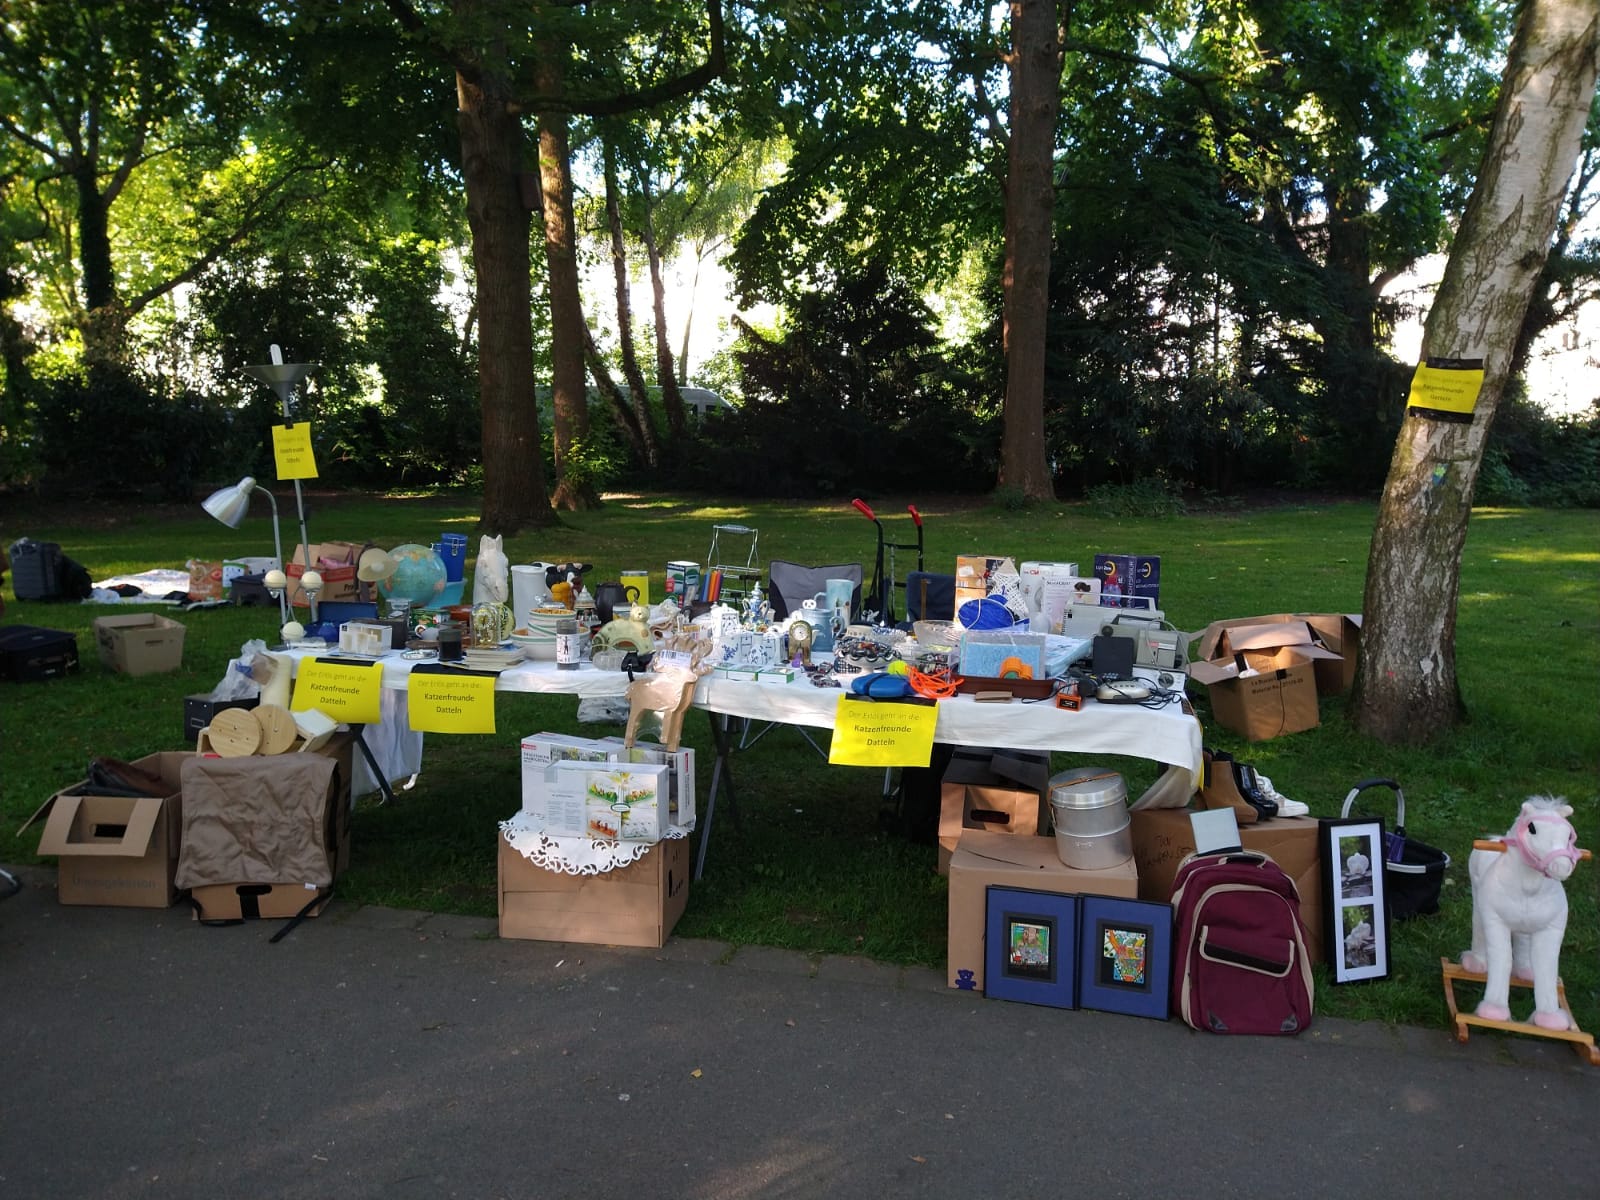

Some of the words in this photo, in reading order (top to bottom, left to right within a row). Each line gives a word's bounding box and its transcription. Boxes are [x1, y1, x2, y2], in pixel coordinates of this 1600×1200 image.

[310, 682, 360, 694] Katzenfreunde
[320, 696, 346, 705] Datteln
[424, 692, 475, 702] Katzenfreunde
[436, 706, 462, 714] Datteln
[854, 723, 912, 734] Katzenfreunde
[866, 737, 895, 746] Datteln
